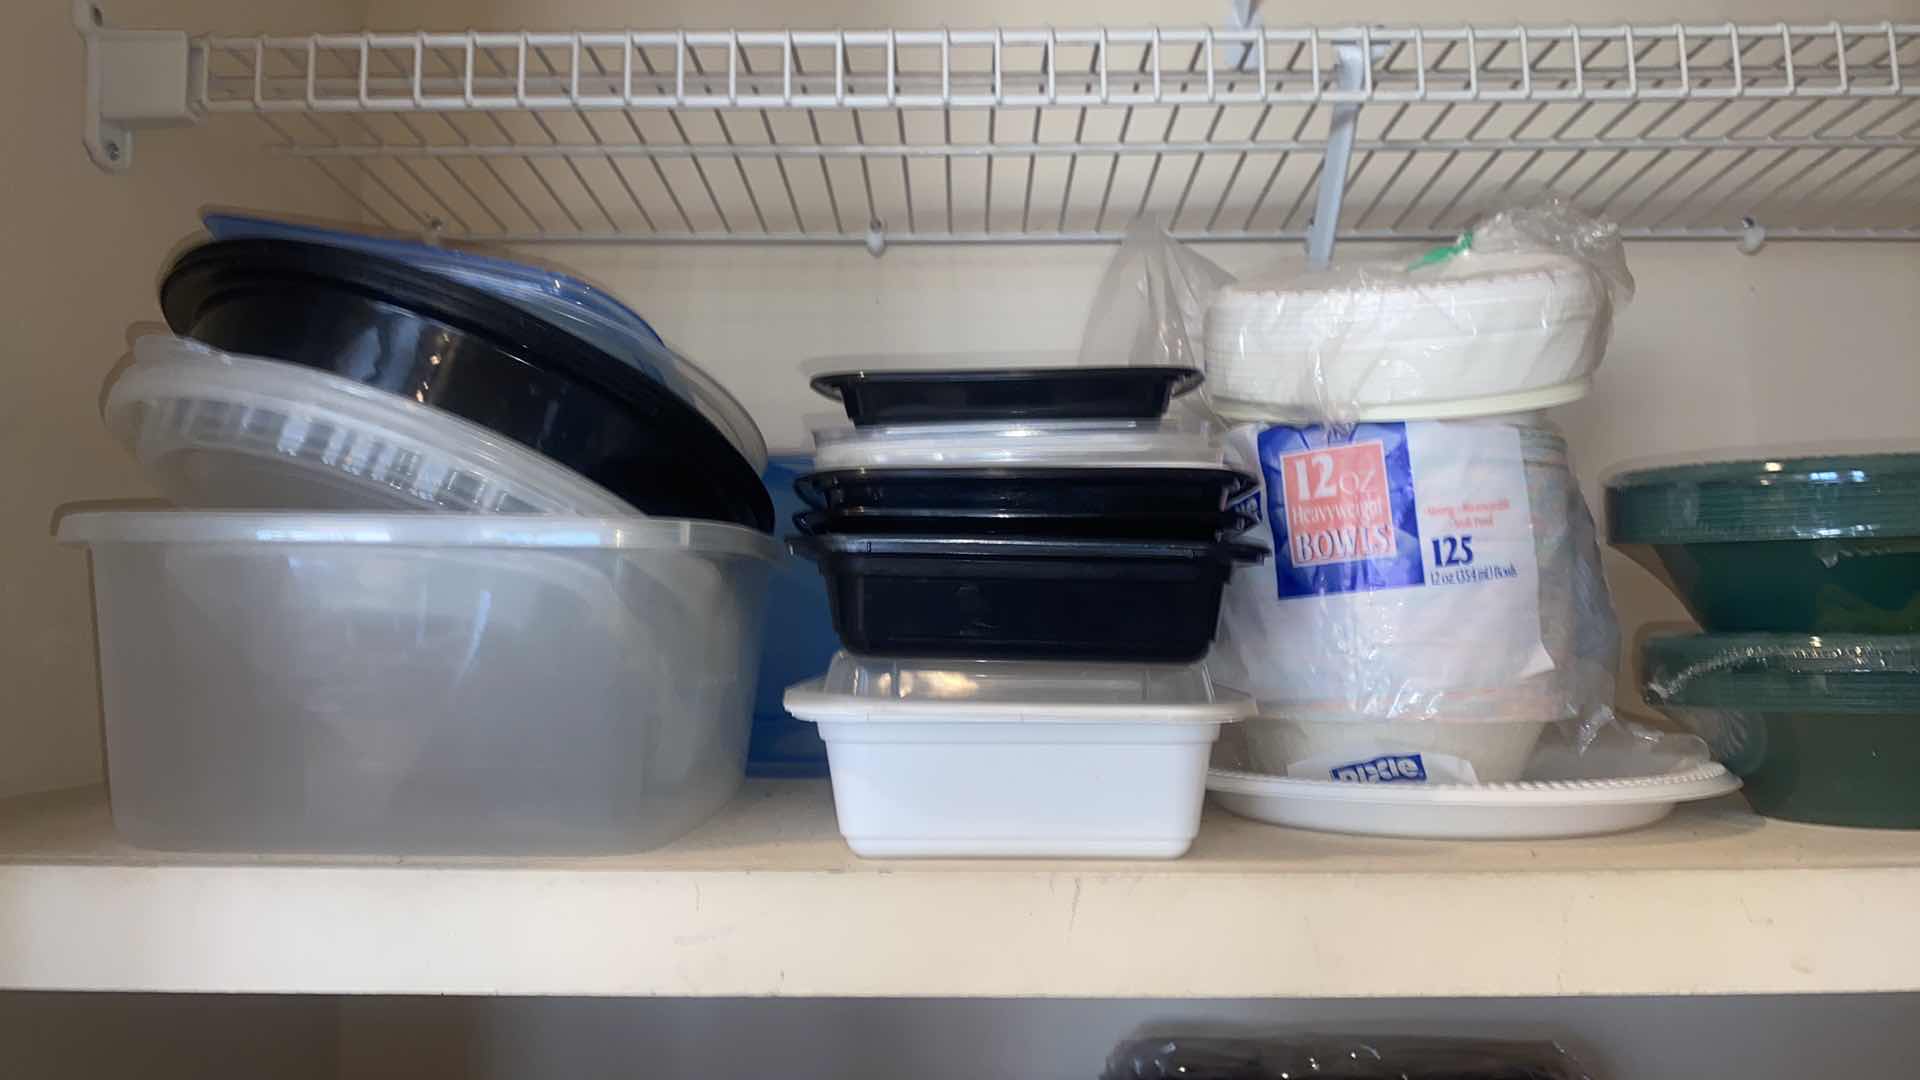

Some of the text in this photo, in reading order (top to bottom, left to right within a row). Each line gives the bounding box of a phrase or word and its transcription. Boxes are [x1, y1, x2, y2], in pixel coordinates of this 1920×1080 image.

[1294, 455, 1338, 501] 12
[1292, 496, 1384, 525] Heavyweight
[1295, 522, 1392, 561] BOWLS
[1432, 534, 1473, 567] 125
[1430, 571, 1441, 585] 12
